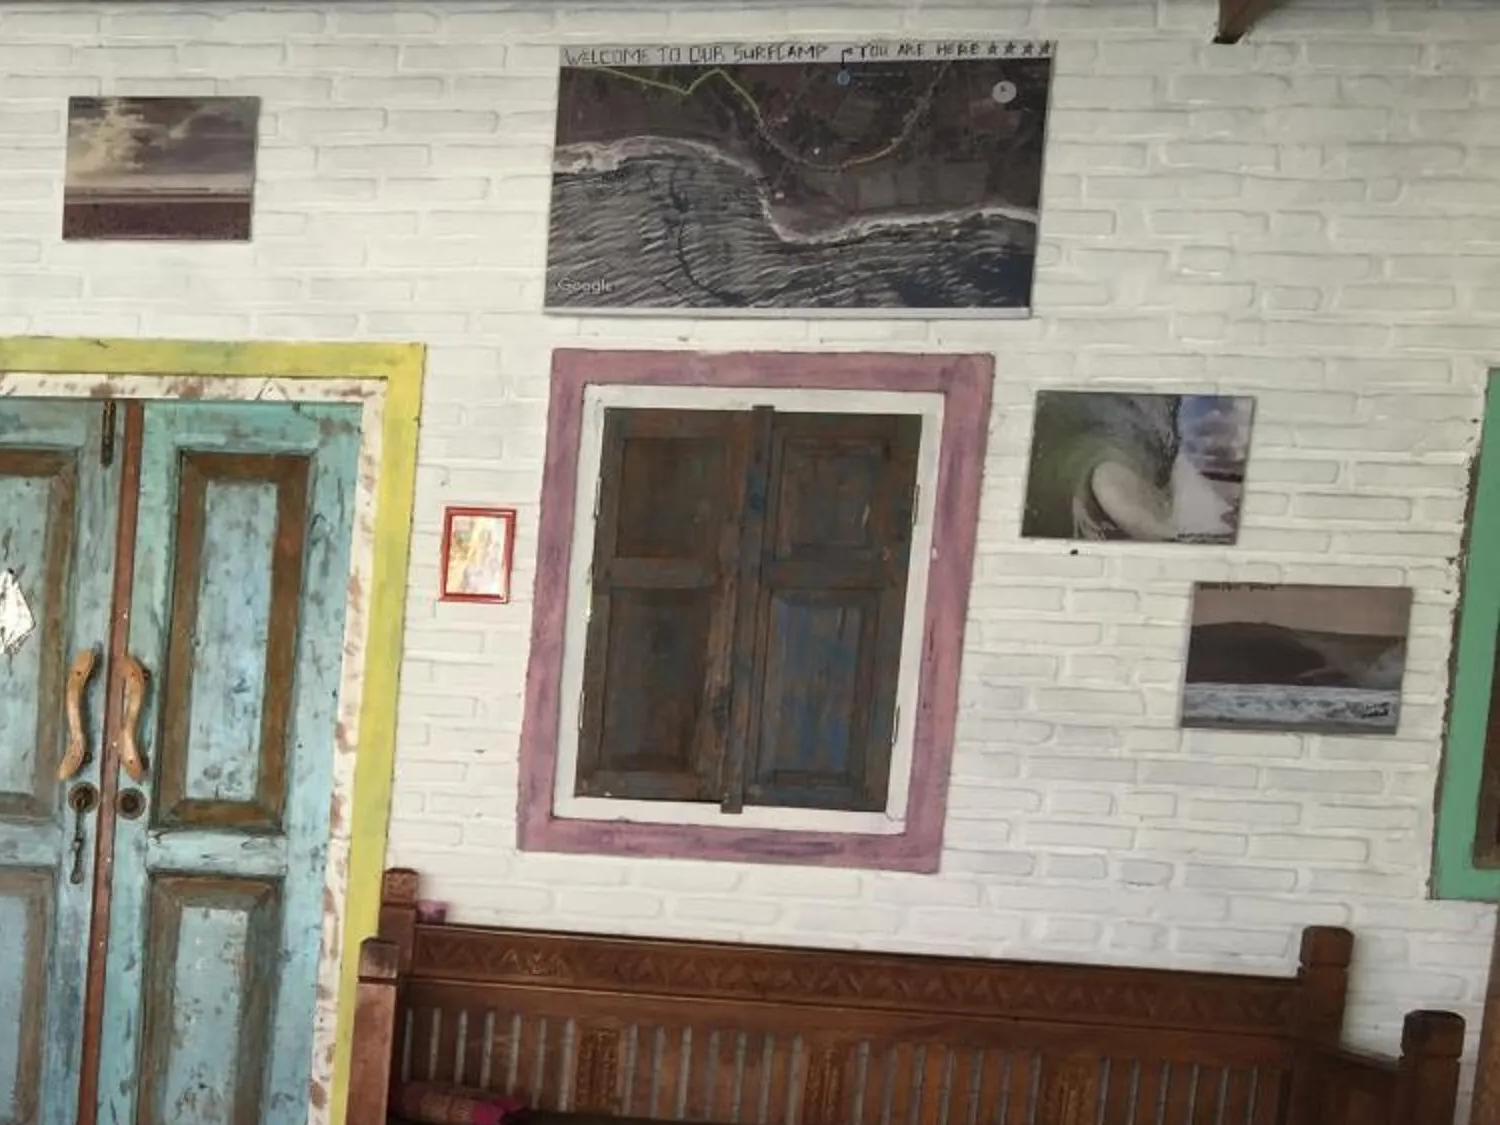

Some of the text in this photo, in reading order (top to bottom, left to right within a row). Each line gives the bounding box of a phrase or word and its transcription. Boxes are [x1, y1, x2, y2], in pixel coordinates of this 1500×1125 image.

[563, 47, 649, 66] WELCOME
[657, 46, 682, 64] TO
[688, 46, 725, 63] OUR
[731, 44, 828, 62] SURFCAMP
[897, 42, 925, 57] ARE
[936, 42, 980, 57] HERE
[557, 278, 613, 295] Google
